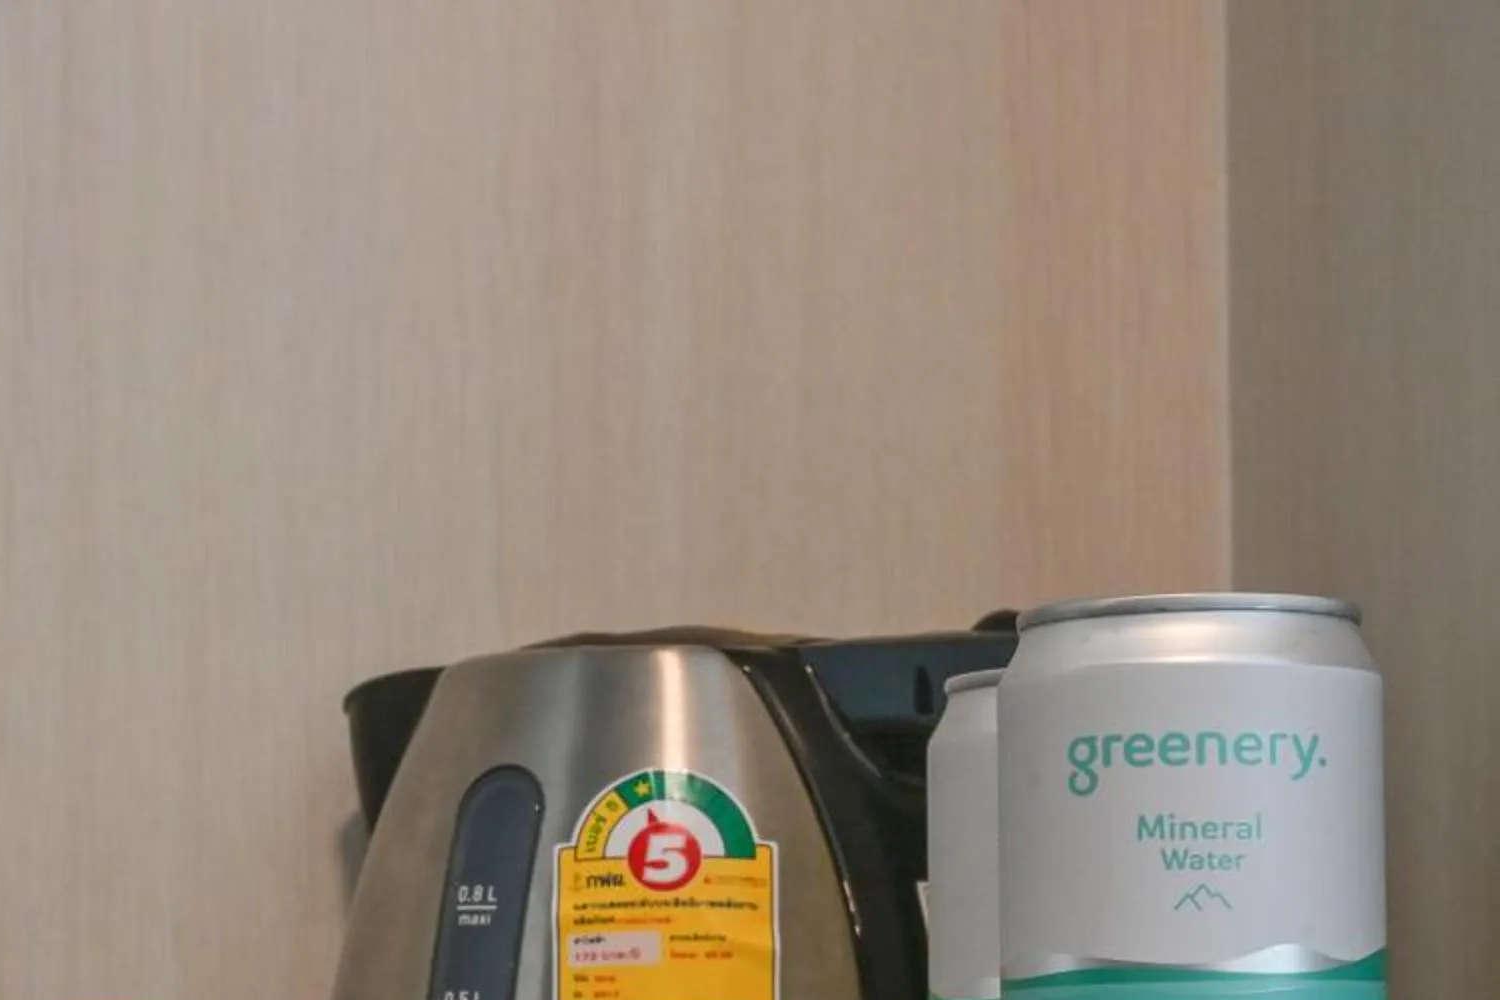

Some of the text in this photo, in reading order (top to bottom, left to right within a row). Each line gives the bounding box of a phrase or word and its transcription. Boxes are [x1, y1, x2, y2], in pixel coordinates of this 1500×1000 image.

[1067, 730, 1327, 796] greenery.
[1136, 813, 1262, 843] Mineral
[642, 832, 690, 884] 5
[1161, 848, 1245, 872] Water
[458, 885, 496, 903] 0.8 L
